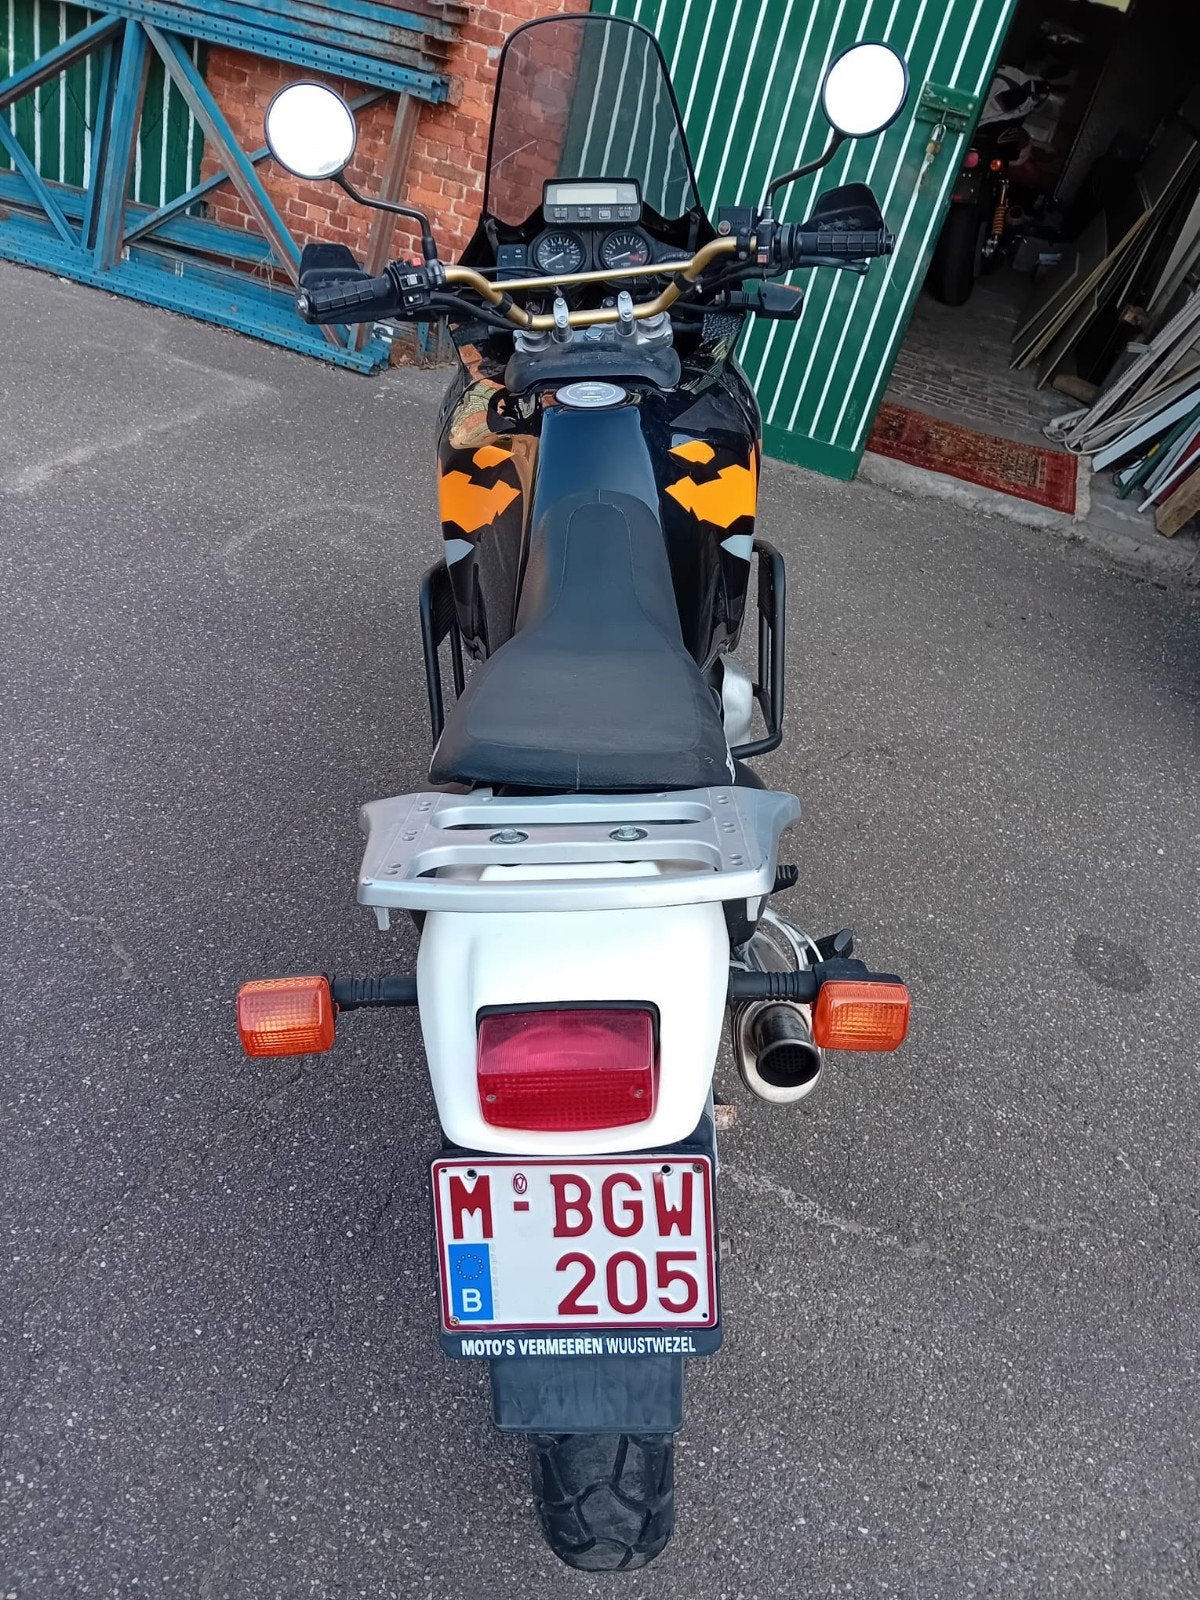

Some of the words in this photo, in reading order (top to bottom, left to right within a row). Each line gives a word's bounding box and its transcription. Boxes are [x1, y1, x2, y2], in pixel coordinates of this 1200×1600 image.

[555, 1250, 699, 1316] 205
[461, 1288, 483, 1313] B
[461, 1339, 516, 1356] MOTO'S
[518, 1338, 603, 1355] VERMEEREN
[605, 1336, 697, 1354] WUUSTWEZEL
